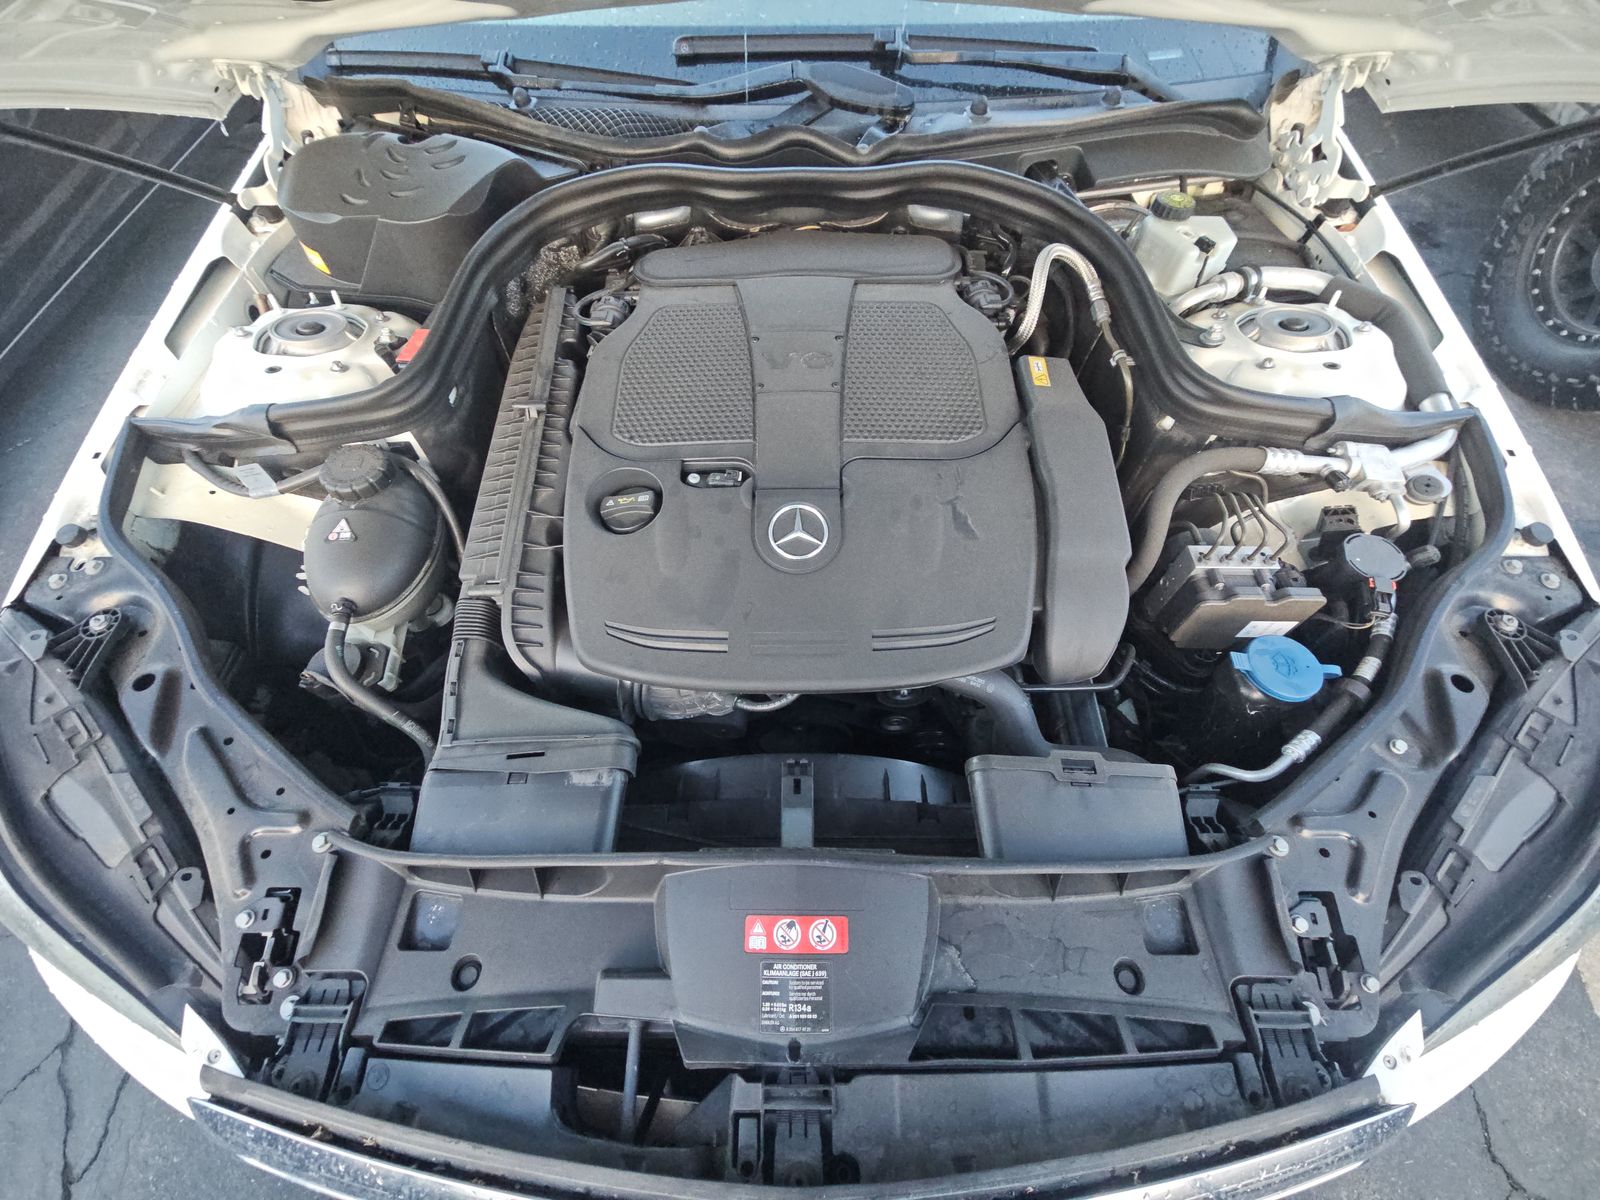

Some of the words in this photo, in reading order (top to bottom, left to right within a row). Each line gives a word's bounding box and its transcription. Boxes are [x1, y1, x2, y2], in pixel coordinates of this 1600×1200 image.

[800, 970, 811, 978] (SAE
[815, 970, 827, 978] 639)
[788, 1003, 812, 1012] R134a
